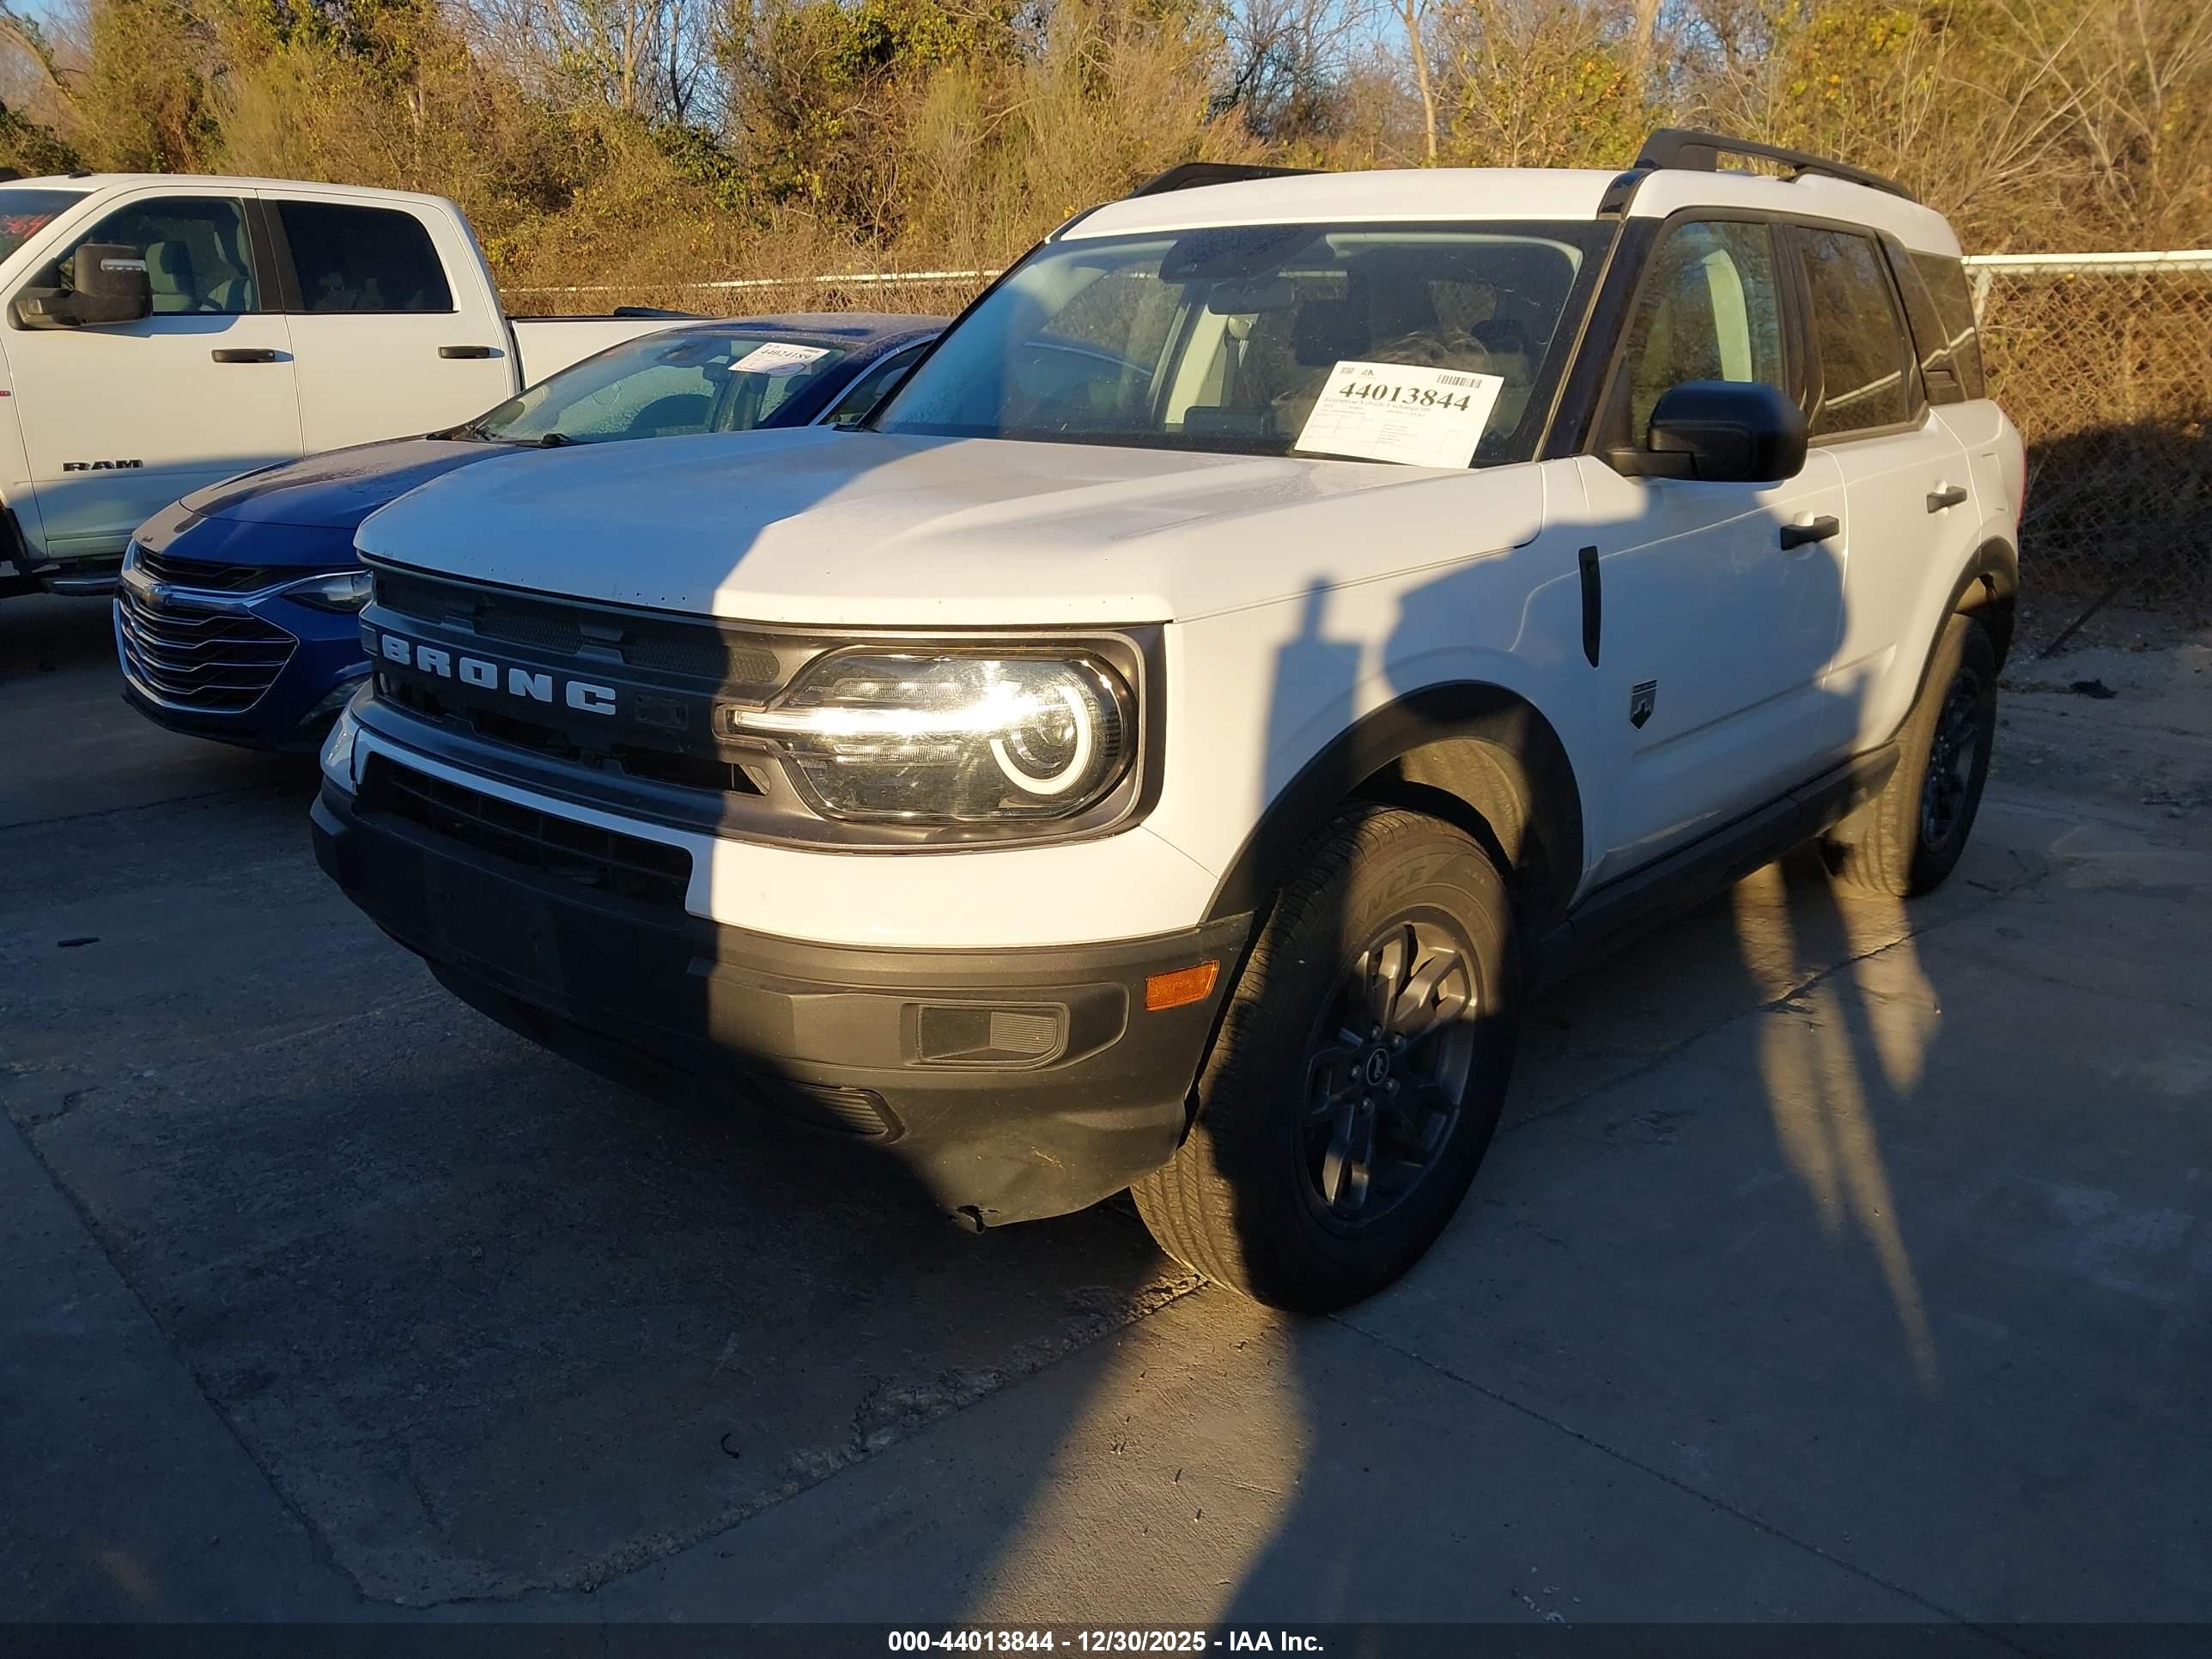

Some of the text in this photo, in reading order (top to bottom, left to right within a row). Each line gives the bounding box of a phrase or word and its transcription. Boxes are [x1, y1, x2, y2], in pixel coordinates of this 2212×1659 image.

[1340, 381, 1472, 411] 44013844
[63, 459, 143, 471] RAM
[381, 634, 617, 715] BRONC
